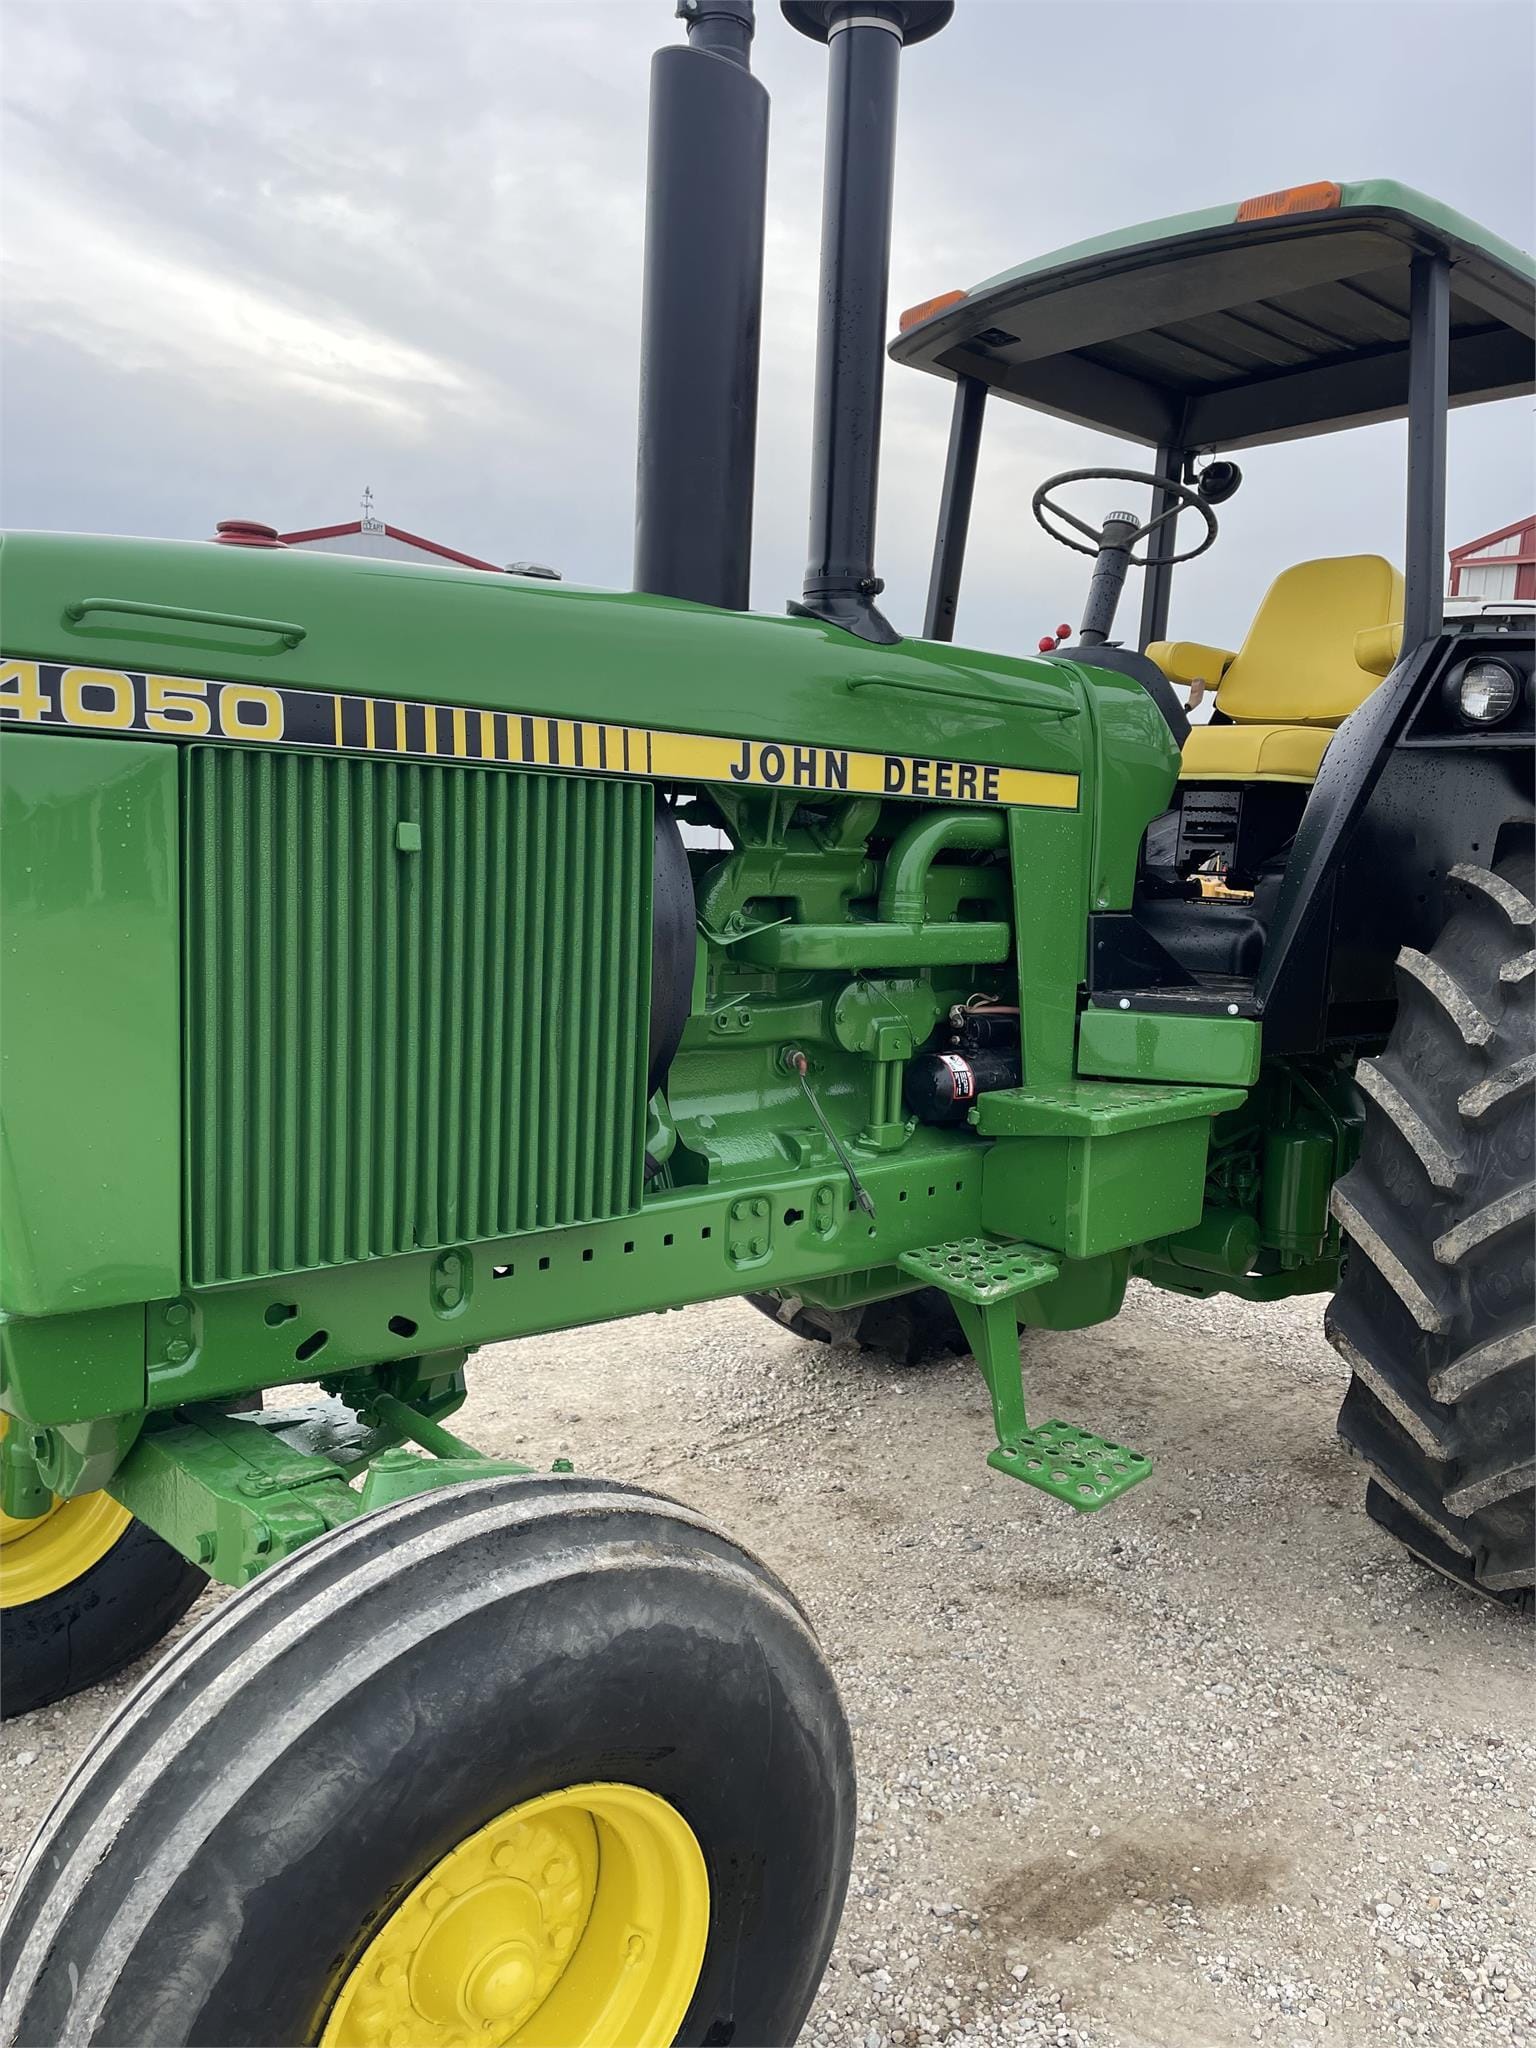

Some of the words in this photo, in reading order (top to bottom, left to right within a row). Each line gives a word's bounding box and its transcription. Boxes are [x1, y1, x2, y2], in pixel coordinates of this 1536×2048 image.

[0, 660, 284, 741] 4050
[730, 741, 848, 789] JOHN
[884, 756, 1000, 801] DEERE
